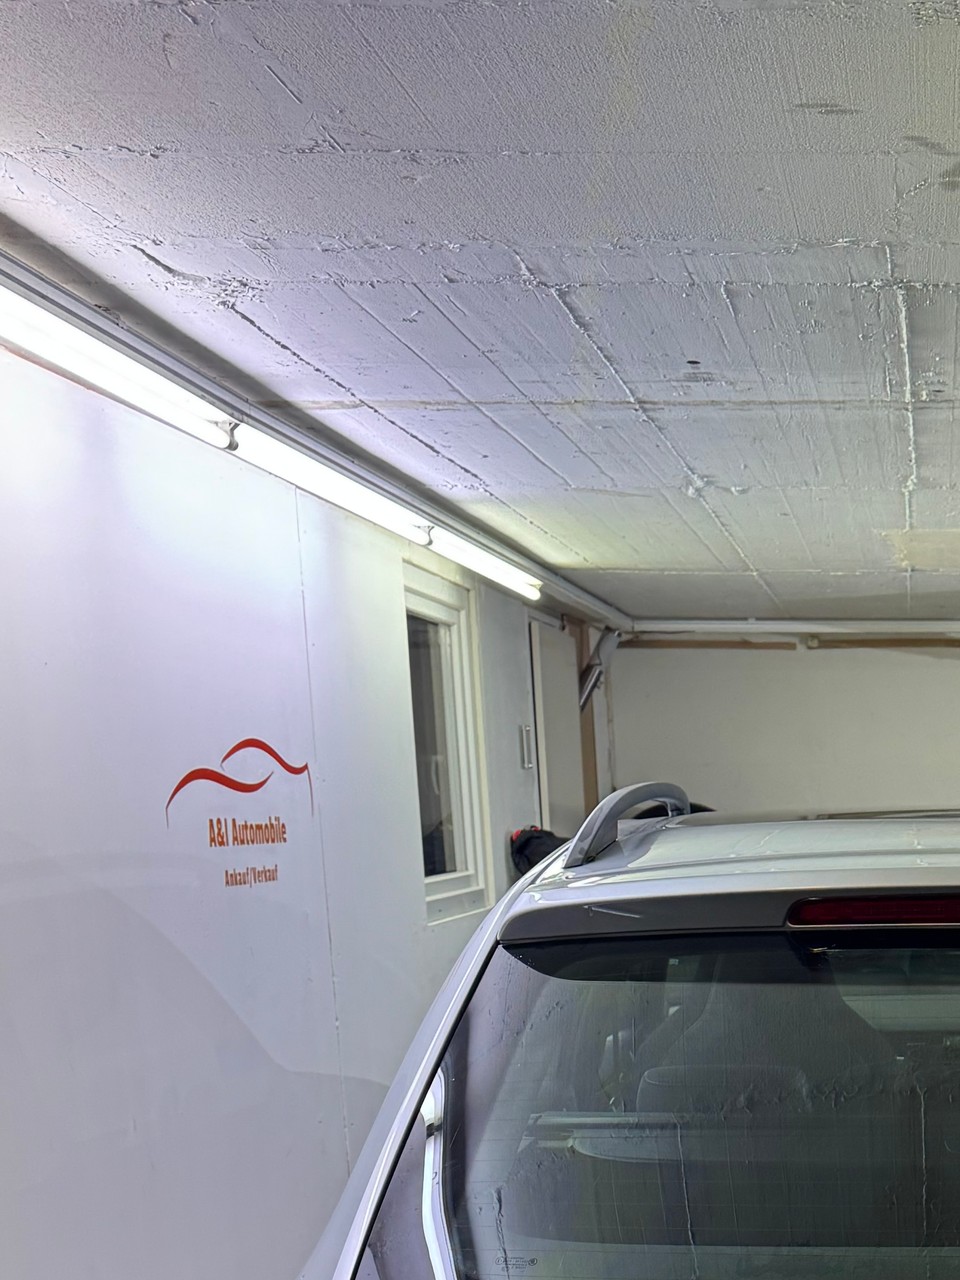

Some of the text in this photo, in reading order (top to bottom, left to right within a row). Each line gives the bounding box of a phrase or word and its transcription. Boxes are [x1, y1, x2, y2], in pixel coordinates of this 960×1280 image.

[208, 816, 287, 848] A&I Automobile
[224, 864, 278, 888] Ankauf/Verkauf
